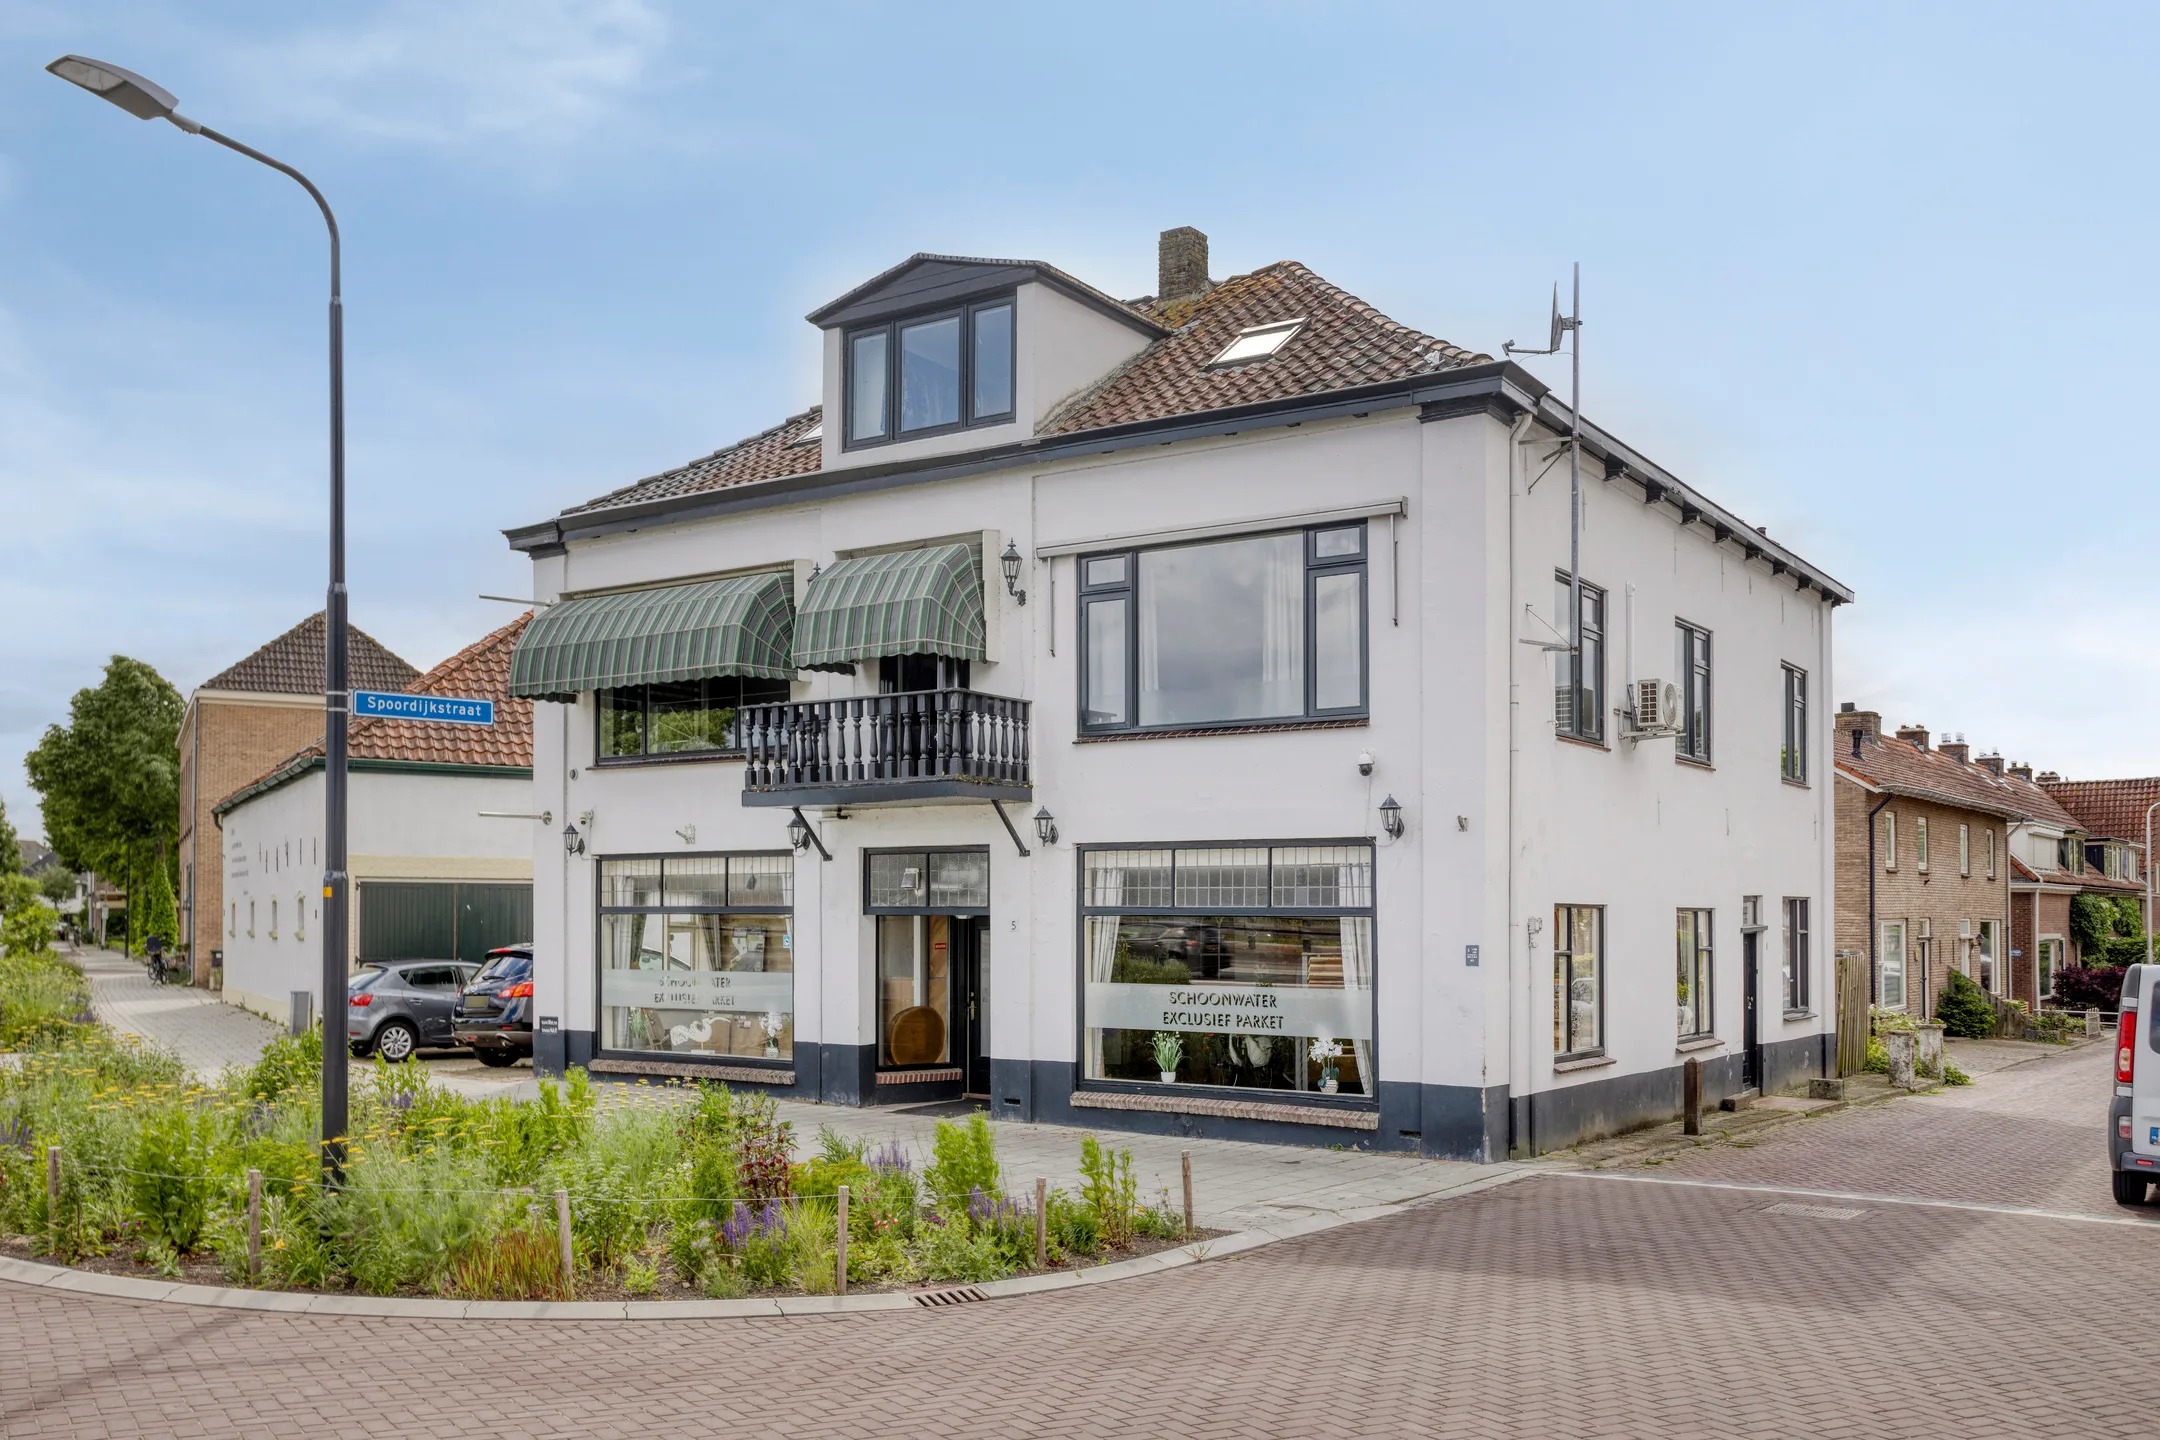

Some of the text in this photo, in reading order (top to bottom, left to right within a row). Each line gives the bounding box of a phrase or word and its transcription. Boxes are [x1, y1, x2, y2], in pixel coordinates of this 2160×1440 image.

[367, 696, 482, 717] Spoordijkstraat
[1011, 920, 1017, 931] 5
[1169, 991, 1277, 1008] SCHOONWATER
[1163, 1011, 1284, 1030] EXCLUSIEF PARKET
